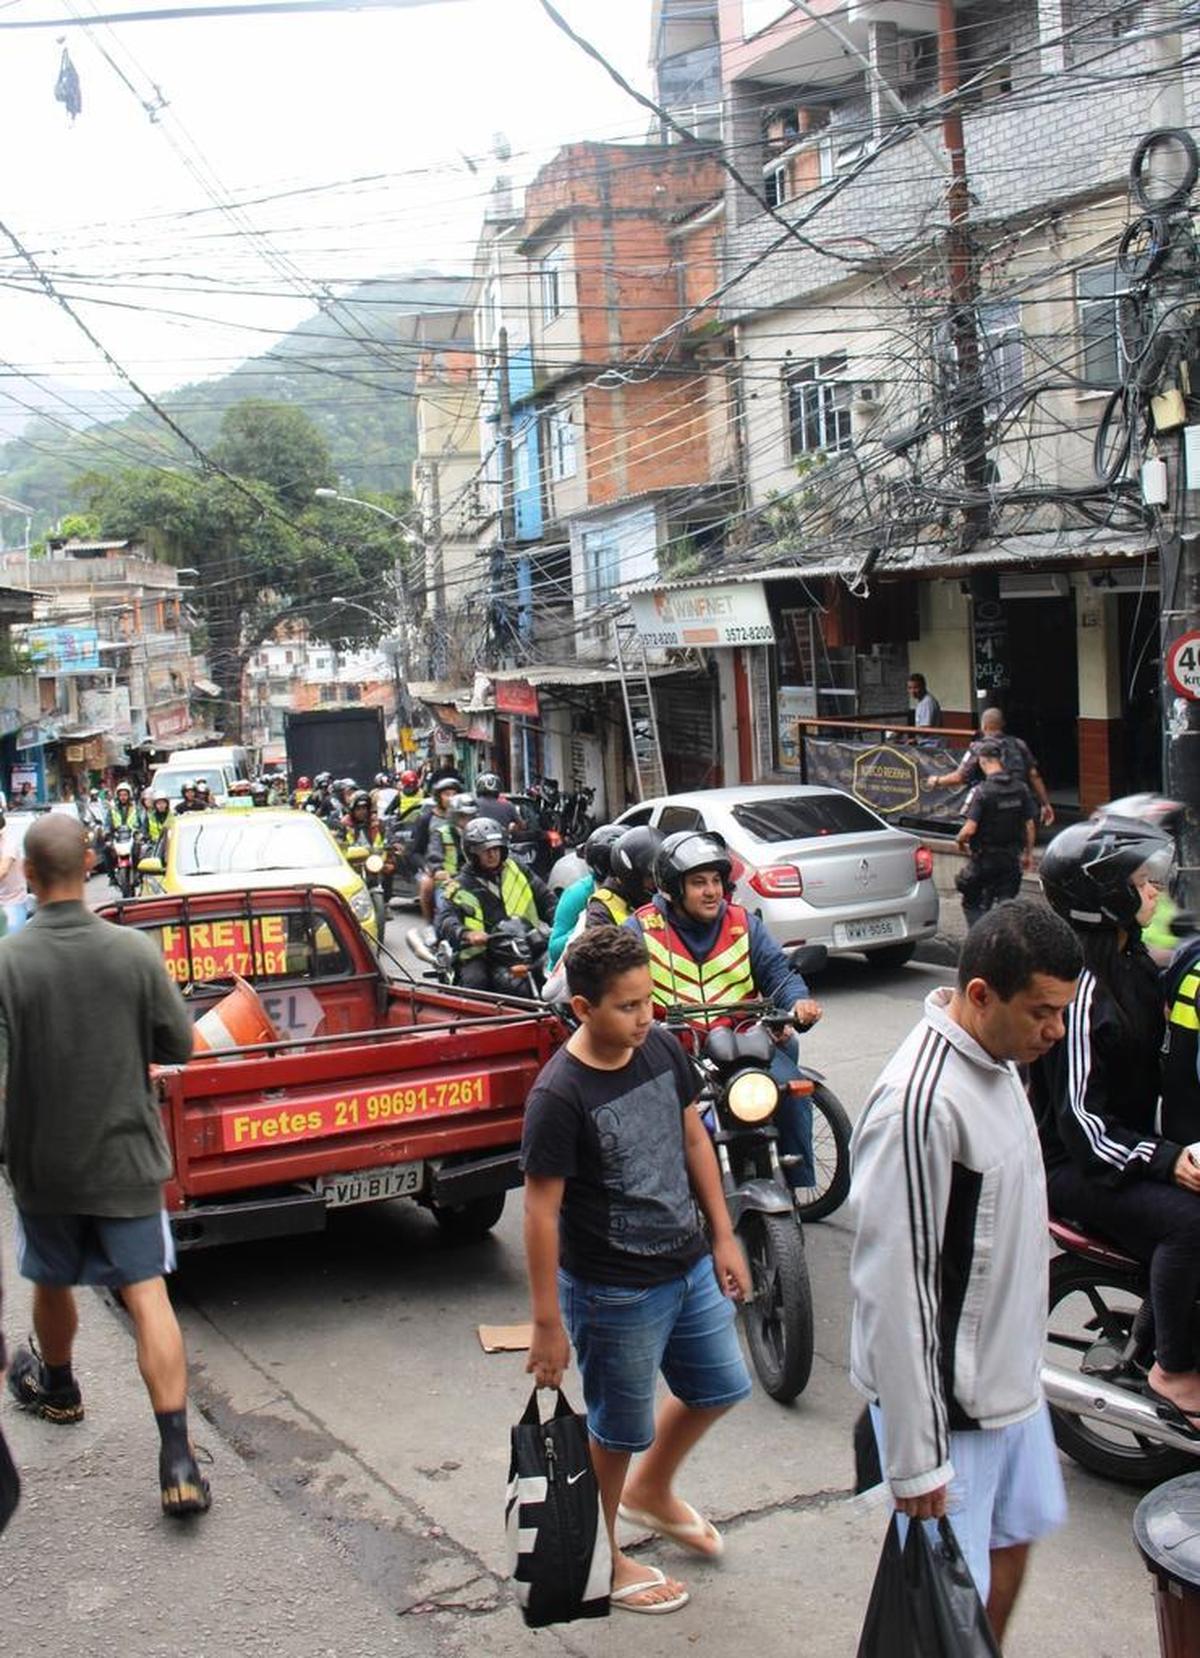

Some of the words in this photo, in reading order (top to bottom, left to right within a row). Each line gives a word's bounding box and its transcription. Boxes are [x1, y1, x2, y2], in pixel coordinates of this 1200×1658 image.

[725, 625, 772, 642] 3572-8200
[162, 916, 284, 951] FRETE
[233, 1111, 322, 1142] Fretes
[334, 1097, 359, 1126] 21
[366, 1077, 483, 1120] 99691-7261
